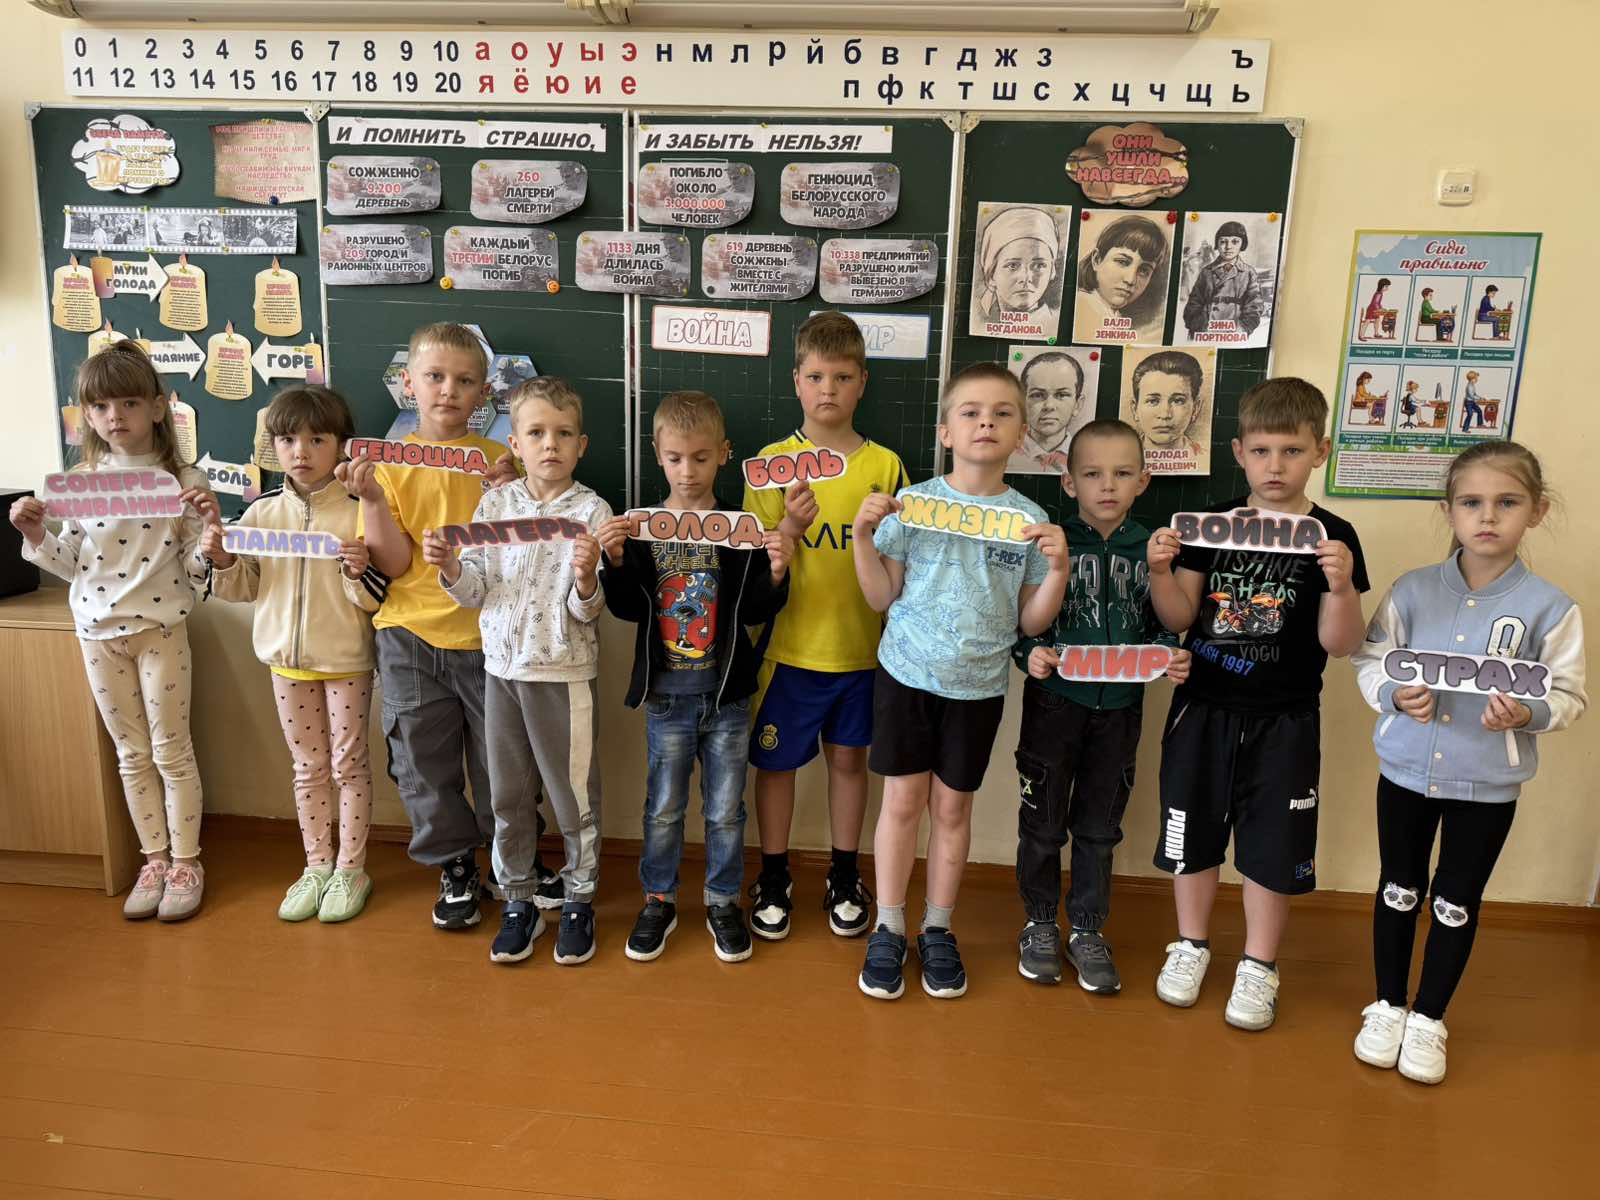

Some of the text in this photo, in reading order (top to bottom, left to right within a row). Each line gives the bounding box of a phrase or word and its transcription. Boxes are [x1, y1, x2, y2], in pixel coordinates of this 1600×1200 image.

[76, 38, 86, 57] 0
[109, 38, 117, 57] 1
[146, 39, 157, 58] 2
[183, 39, 194, 58] 3
[216, 40, 229, 59] 4
[256, 40, 267, 59] 5
[292, 40, 303, 60] 6
[328, 41, 339, 60] 7
[364, 41, 375, 61] 8
[401, 41, 412, 61] 9
[434, 41, 458, 61] 10
[476, 42, 489, 60] а
[512, 42, 527, 60] о
[581, 43, 603, 61] ы
[622, 43, 636, 61] э
[657, 44, 672, 62] н
[693, 44, 712, 62] м
[731, 45, 748, 63] л
[845, 39, 861, 64] б
[882, 47, 898, 65] в
[926, 48, 938, 65] г
[957, 48, 977, 71] д
[995, 48, 1018, 67] ж
[1037, 48, 1051, 67] з
[74, 68, 93, 86] 11
[111, 68, 135, 87] 12
[151, 69, 174, 88] 13
[190, 69, 215, 89] 14
[230, 70, 254, 90] 15
[272, 71, 297, 91] 16
[313, 72, 336, 91] 17
[353, 72, 377, 91] 18
[393, 72, 417, 92] 19
[435, 72, 460, 93] 20
[479, 76, 493, 92] я
[514, 69, 528, 93] ё
[546, 76, 569, 94] ю
[585, 76, 600, 93] и
[622, 76, 636, 94] е
[840, 80, 859, 98] п
[878, 74, 903, 103] ф
[920, 81, 934, 99] к
[958, 82, 973, 100] т
[993, 82, 1016, 100] ш
[1034, 82, 1049, 100] с
[1073, 83, 1090, 101] х
[1112, 84, 1129, 106] ц
[1150, 84, 1165, 101] ч
[1187, 84, 1211, 107] щ
[337, 127, 596, 150] И ПОМНИТЬ СТРАШНО,
[645, 134, 862, 150] И ЗАБЫТЬ НЕЛЬЗЯ!
[1113, 134, 1153, 149] ОНИ
[1106, 151, 1161, 166] УШЛИ
[348, 166, 420, 178] СОЖЖЕННО
[517, 171, 540, 182] 260
[670, 167, 723, 178] ПОГИБЛО
[807, 174, 873, 187] ГЕННОЦИД
[504, 185, 555, 199] ЛАГЕРЕЙ
[676, 183, 717, 194] ОКОЛО
[791, 190, 886, 202] БЕЛОРУССКОГО
[355, 198, 411, 208] ДЕРЕВЕНЬ
[506, 203, 553, 213] СМЕРТИ
[671, 212, 719, 224] ЧЕЛОВЕК
[813, 206, 866, 220] НАРОДА
[346, 236, 406, 246] РАЗРУШЕНО
[470, 236, 530, 250] КАЖДЫЙ
[726, 242, 793, 253] 619 ДЕРЕВЕНЬ
[1425, 239, 1466, 256] Сиди
[607, 242, 661, 255] 1133 ДНЯ
[498, 253, 552, 266] БЕЛОРУС
[604, 258, 664, 270] ДЛИЛАСЬ
[730, 255, 787, 267] СОЖЖЕНЫ
[1400, 256, 1489, 273] правильно
[114, 264, 148, 276] МУКИ
[327, 261, 426, 272] РАЙОННЫХ ЦЕНТРОВ
[839, 263, 919, 274] РАЗРУШЕНО ИЛИ
[482, 269, 522, 281] ПОГИБ
[613, 273, 654, 285] ВОЙНА
[737, 269, 781, 280] ВМЕСТЕ С
[850, 276, 898, 285] ВЫВЕЗЕНО
[106, 277, 157, 290] ГОЛОДА
[730, 282, 788, 293] ЖИТЕЛЯМИ
[851, 288, 904, 298] ГЕРМАНИЮ
[1001, 312, 1029, 323] НАДЯ
[1103, 318, 1131, 328] ВАЛЯ
[667, 312, 753, 348] ВОЙНА
[986, 323, 1042, 335] БОГДАНОВА
[1208, 320, 1235, 331] ЗИНА
[860, 324, 896, 351] ИР
[1095, 330, 1137, 340] ЗЕНКИНА
[1194, 333, 1248, 343] ПОРТНОВА
[266, 353, 314, 370] ГОРЕ
[351, 439, 488, 474] ГЕНОЦИД
[1145, 450, 1189, 460] ВОЛОДЯ
[782, 449, 844, 487] БОЛЬ
[207, 467, 252, 487] БОЛЬ
[47, 495, 183, 518] ЖИВАНИЕ
[900, 493, 1035, 543] ЖИЗНЬ
[442, 517, 589, 547] ЛАГЕРЬ
[627, 511, 764, 547] ГОЛОД
[1174, 508, 1324, 550] ВОЙНА
[226, 530, 340, 553] ПАМЯТЬ
[987, 546, 1025, 566] T-REX
[656, 556, 720, 571] WHEELS
[1063, 647, 1169, 678] МИР
[1221, 653, 1255, 676] 1997
[1385, 650, 1548, 698] СТРАХ
[1165, 808, 1187, 860] PUMA
